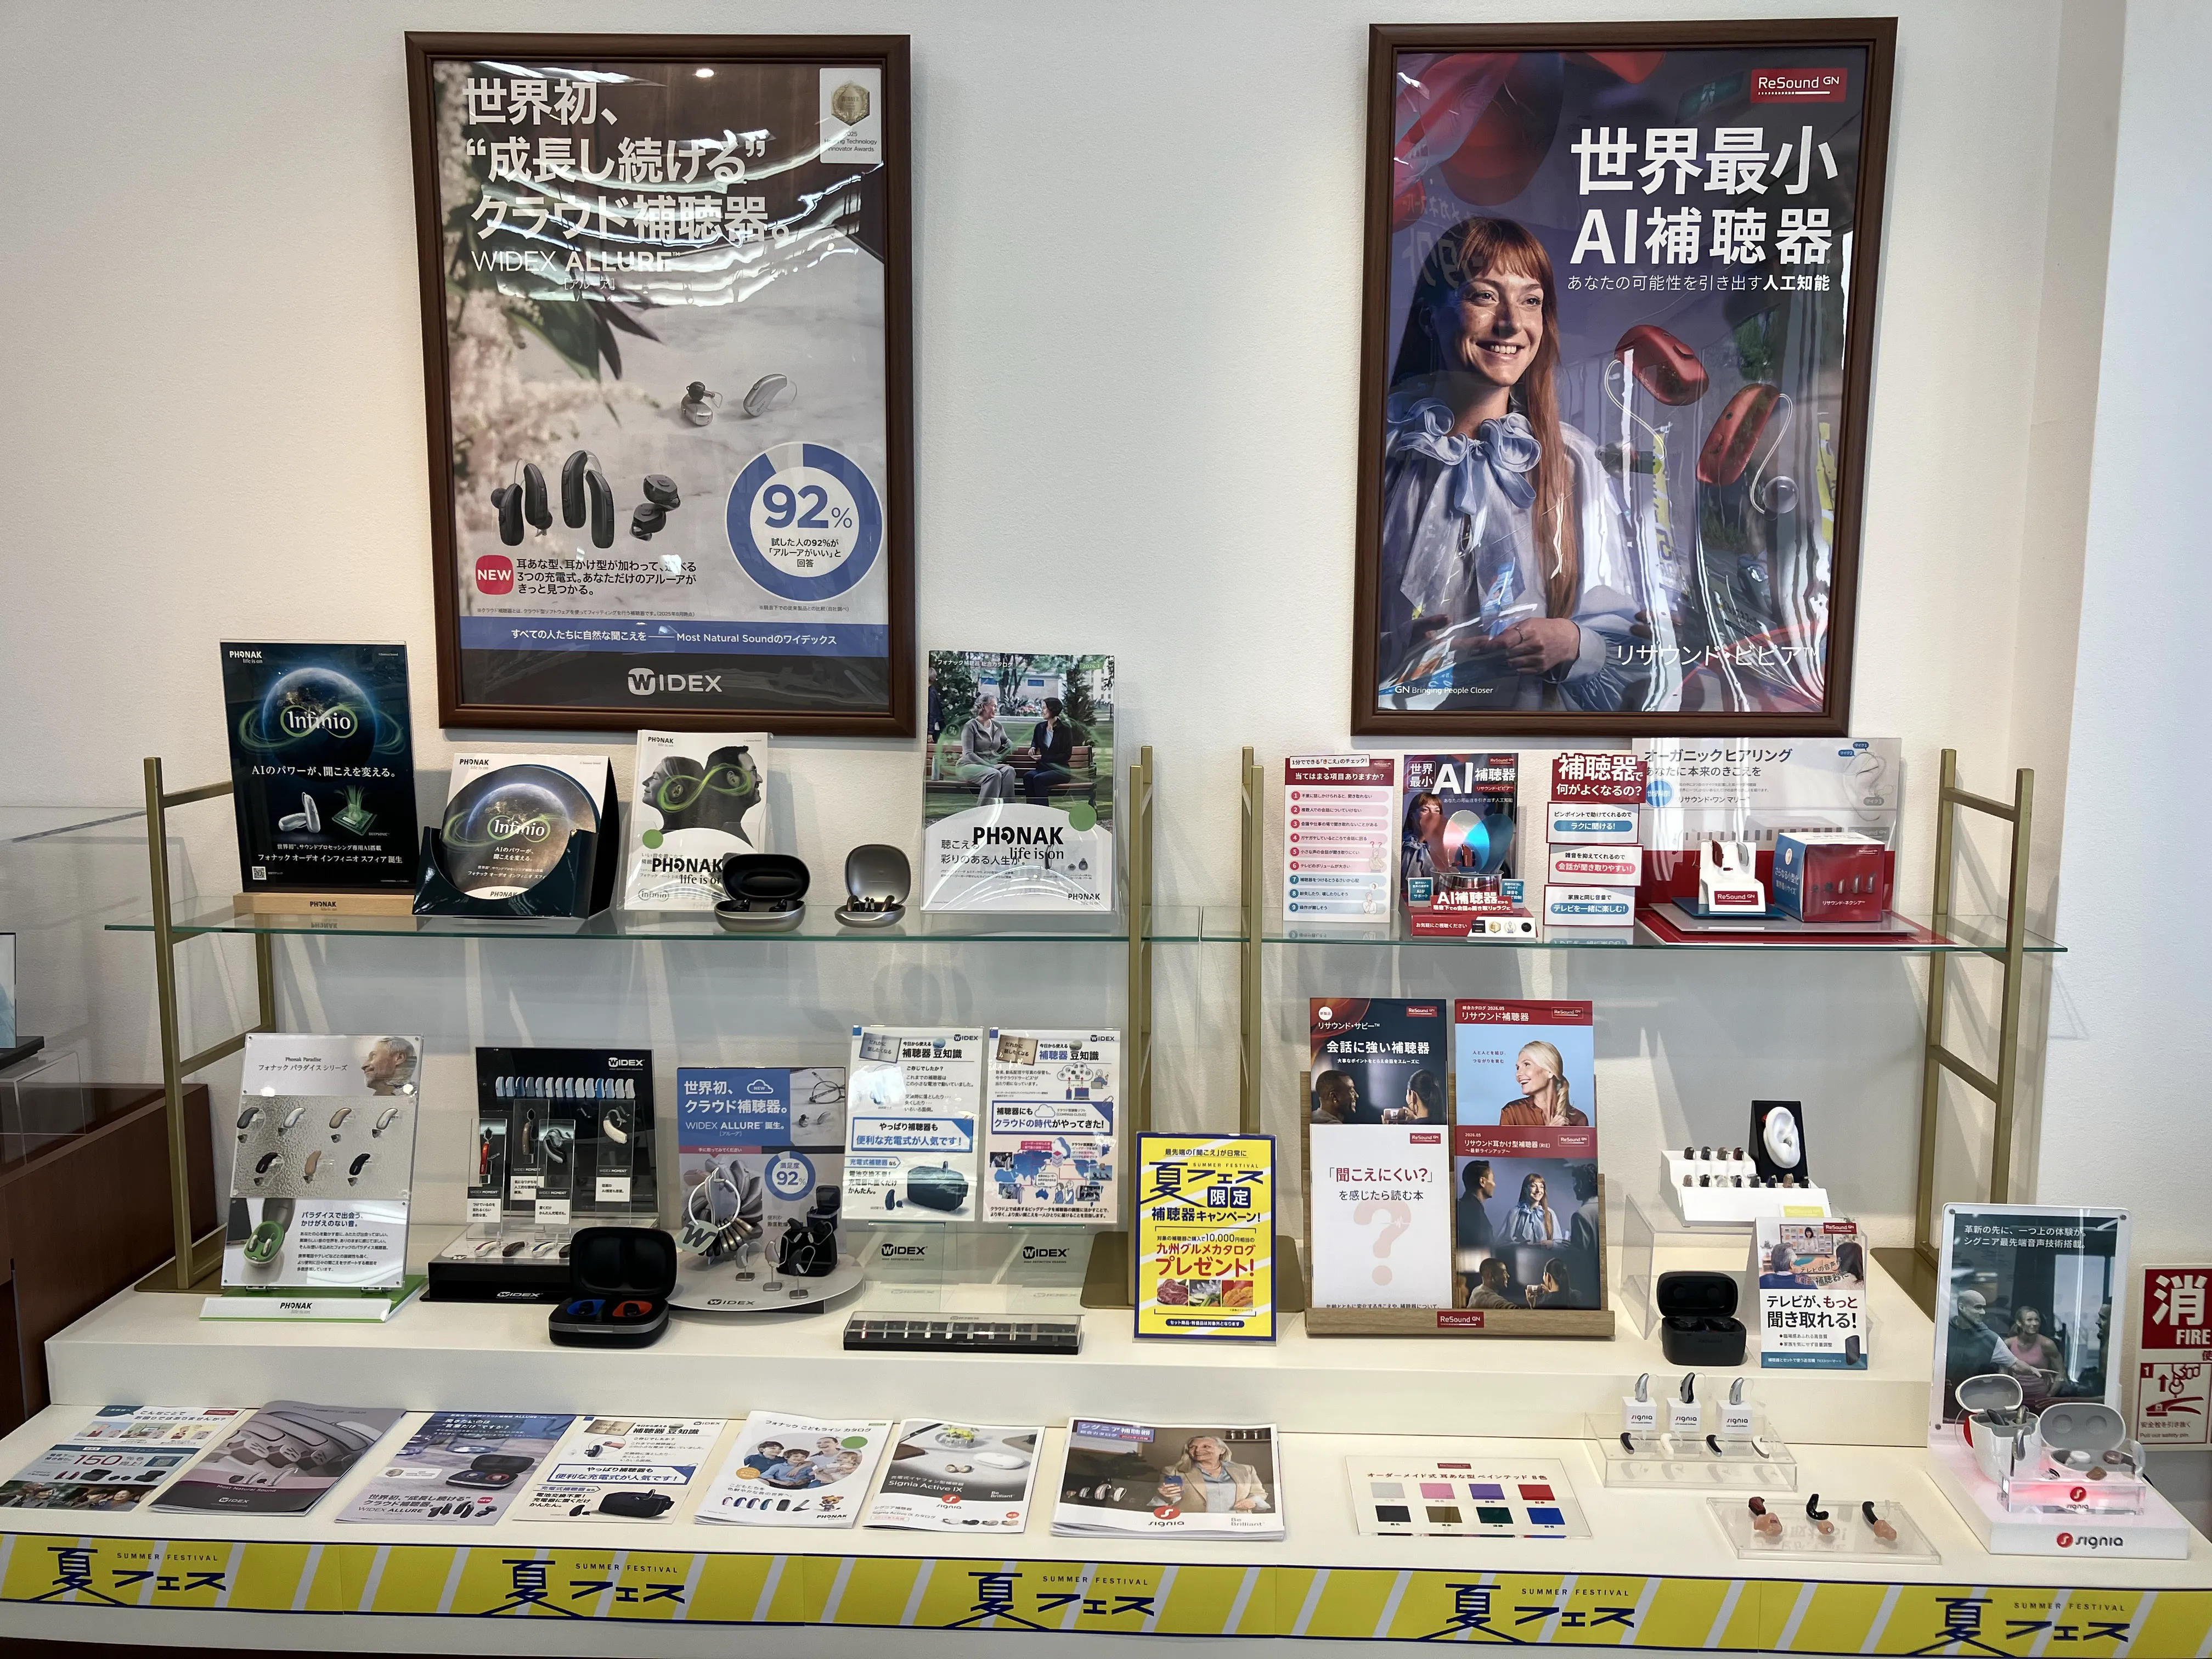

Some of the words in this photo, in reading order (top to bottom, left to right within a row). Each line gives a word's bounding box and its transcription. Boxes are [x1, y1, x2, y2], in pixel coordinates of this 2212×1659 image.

[1758, 76, 1819, 89] ReSound
[1823, 76, 1840, 86] GN
[462, 78, 618, 125] 世界初、
[1571, 125, 1838, 195] 世界最小
[1570, 206, 1832, 265] AI補聴器
[471, 251, 556, 272] WIDEX
[1567, 274, 1831, 291] あなたの可能性を引き出す人工知能
[763, 484, 853, 528] 92%
[771, 538, 839, 548] 試した人の92%が
[797, 559, 814, 568] 回答
[477, 569, 511, 582] NEW
[518, 584, 594, 596] きっと見つかる。
[676, 633, 701, 643] Most
[704, 633, 740, 644] Natural
[628, 667, 723, 695] WIDEX
[1395, 685, 1410, 694] GN
[1412, 685, 1442, 696] Bringing
[1444, 685, 1469, 696] People
[1470, 686, 1494, 695] Closer
[647, 736, 674, 744] PHONAK
[1410, 763, 1433, 775] 世界
[1558, 754, 1644, 782] 補聴器で
[1431, 762, 1474, 795] AI
[1475, 768, 1516, 782] 補聴器
[1409, 776, 1432, 788] 最小
[973, 826, 1064, 845] PHONAK
[258, 854, 290, 862] フォナック
[292, 854, 319, 862] オーデオ
[388, 855, 403, 864] 誕生
[1010, 847, 1031, 860] life
[1034, 848, 1045, 860] is
[1048, 850, 1064, 860] on
[652, 858, 723, 873] PHONAK
[680, 874, 697, 884] life
[699, 874, 708, 884] is
[1437, 891, 1498, 905] AI補聴器
[1462, 1012, 1530, 1022] リサウンド補聴器
[902, 1048, 931, 1059] 補聴器
[933, 1048, 962, 1059] 豆知識
[1326, 1040, 1430, 1054] 会話に強い補聴器
[1039, 1050, 1068, 1060] 補聴器
[1070, 1051, 1099, 1061] 豆知識
[684, 1081, 733, 1095] 世界初、
[996, 1107, 1033, 1115] 補聴器にも
[776, 1171, 806, 1186] 92%
[1210, 1189, 1250, 1206] 限定
[1339, 1189, 1424, 1201] を感じたら読む本
[1156, 1243, 1256, 1256] 九州グルメカタログ
[1155, 1256, 1254, 1277] プレゼント!
[2152, 1275, 2208, 1326] 消
[1767, 1311, 1857, 1329] 聞き取れる!
[2176, 1329, 2211, 1345] FIRE
[72, 1454, 123, 1465] 150
[888, 1480, 918, 1488] Signia
[919, 1483, 951, 1492] Active
[218, 1497, 250, 1505] WIDEX
[2075, 1536, 2124, 1549] signia
[627, 1565, 679, 1573] FESTIVAL
[27, 1547, 227, 1605] 夏フェス
[1042, 1575, 1088, 1583] SUMMER
[1096, 1577, 1149, 1586] FESTIVAL
[479, 1559, 686, 1617] 夏フェス
[1575, 1589, 1630, 1597] FESTIVAL
[943, 1571, 1155, 1631] 夏フェス
[2014, 1602, 2062, 1610] SUMMER
[2069, 1603, 2126, 1612] FESTIVAL
[1417, 1583, 1635, 1643] 夏フェス
[1905, 1597, 2131, 1657] 夏フェス
